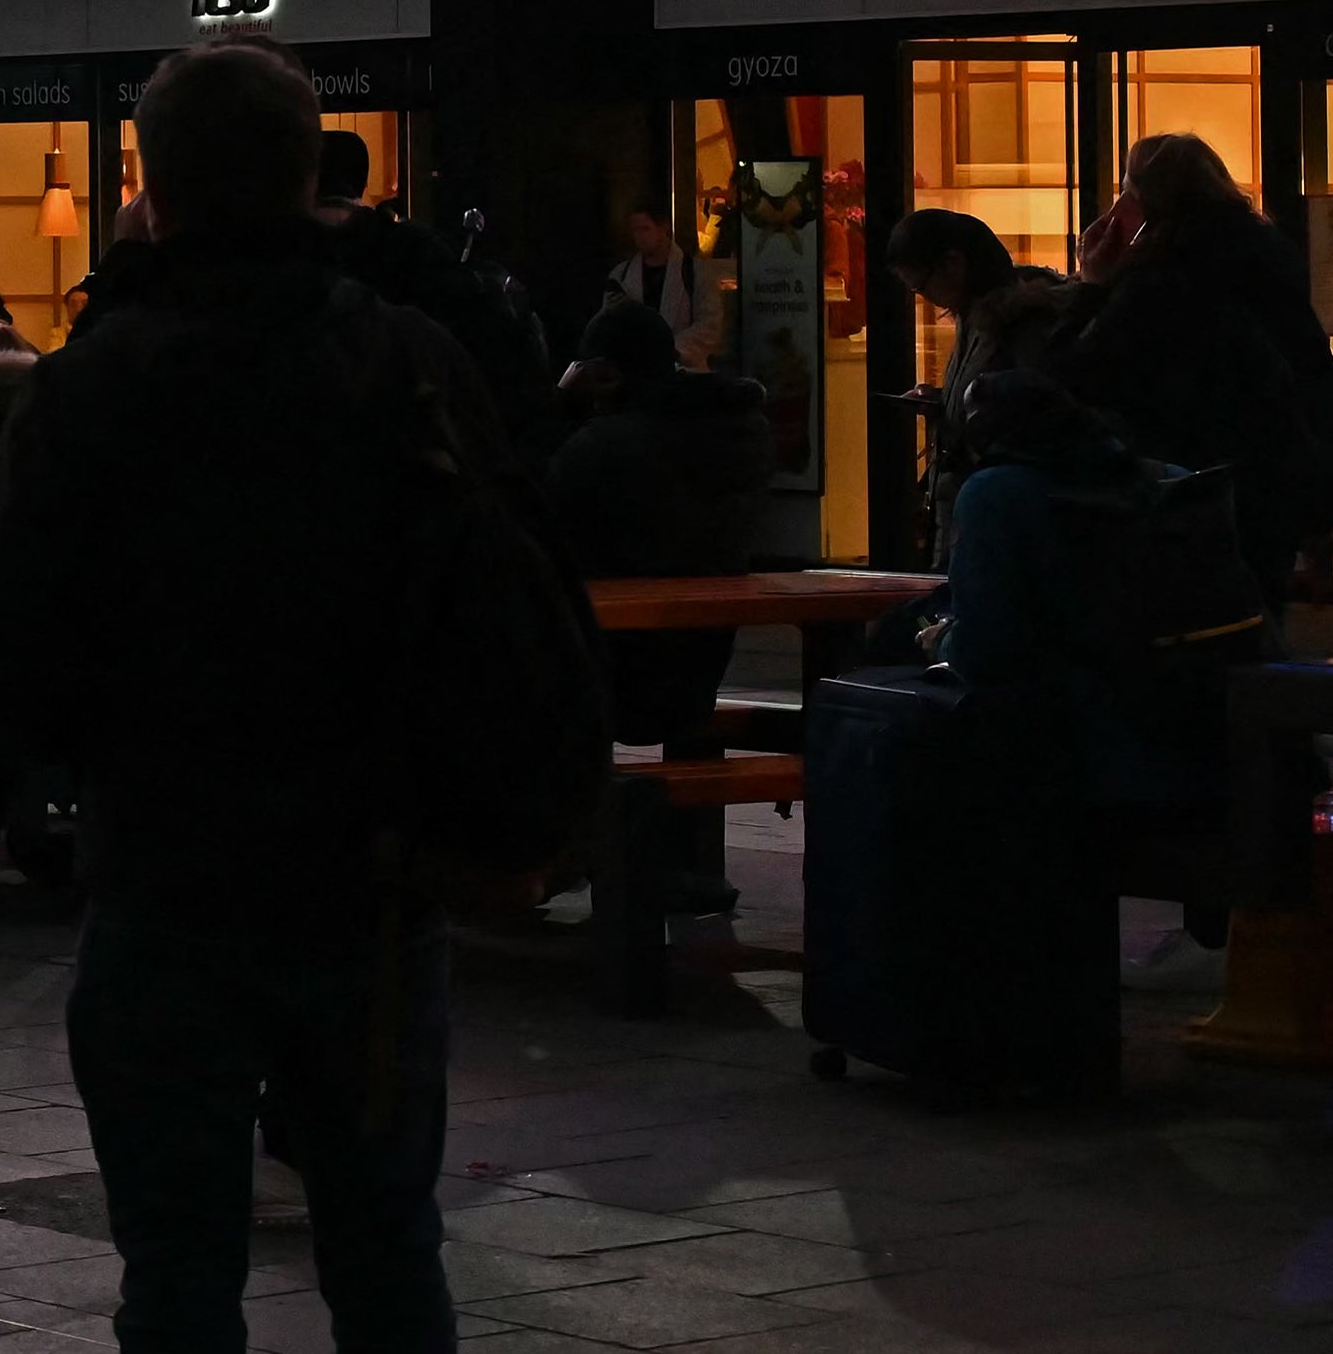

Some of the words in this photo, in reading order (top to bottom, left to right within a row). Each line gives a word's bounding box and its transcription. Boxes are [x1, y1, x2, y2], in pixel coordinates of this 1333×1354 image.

[311, 66, 370, 94] bowls
[728, 53, 798, 87] gyoza
[12, 80, 71, 106] salads
